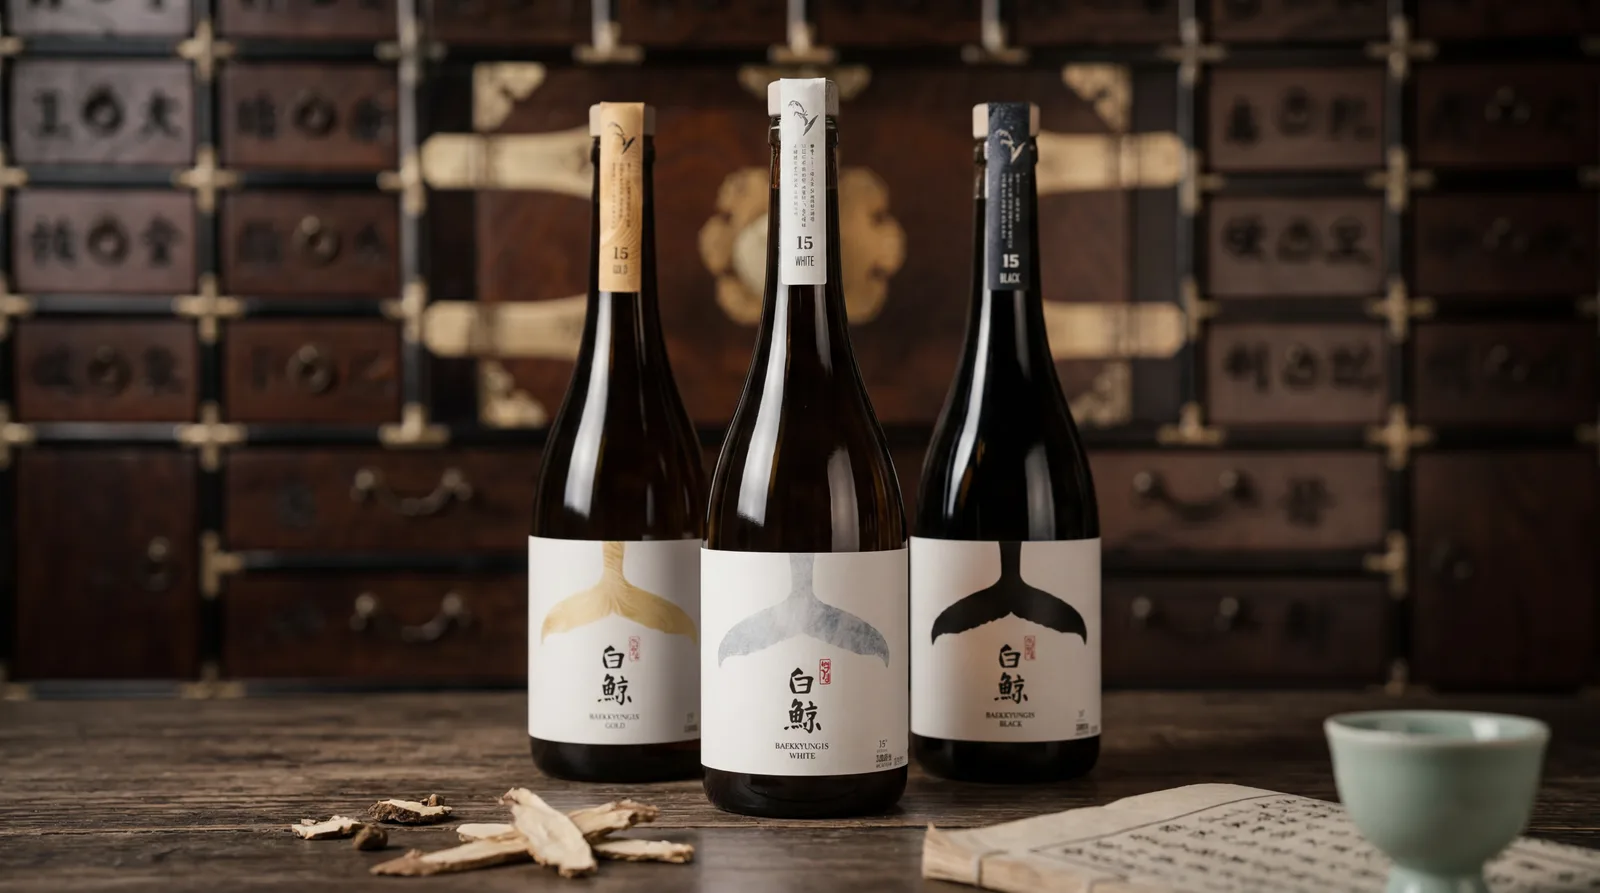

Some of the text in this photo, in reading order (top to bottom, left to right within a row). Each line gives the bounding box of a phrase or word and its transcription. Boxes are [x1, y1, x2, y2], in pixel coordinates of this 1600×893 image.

[796, 235, 814, 250] 15
[613, 246, 629, 260] 15
[794, 255, 815, 267] WHITE
[1002, 253, 1020, 269] 15
[999, 272, 1021, 284] BLACK
[597, 644, 633, 706] 白鯨
[993, 643, 1029, 705] 白鯨
[783, 667, 822, 734] 白鯨
[605, 722, 626, 730] GOLD
[999, 720, 1023, 728] BLACK
[775, 742, 829, 750] BAEKKYUNGIS
[789, 752, 816, 760] WHITE
